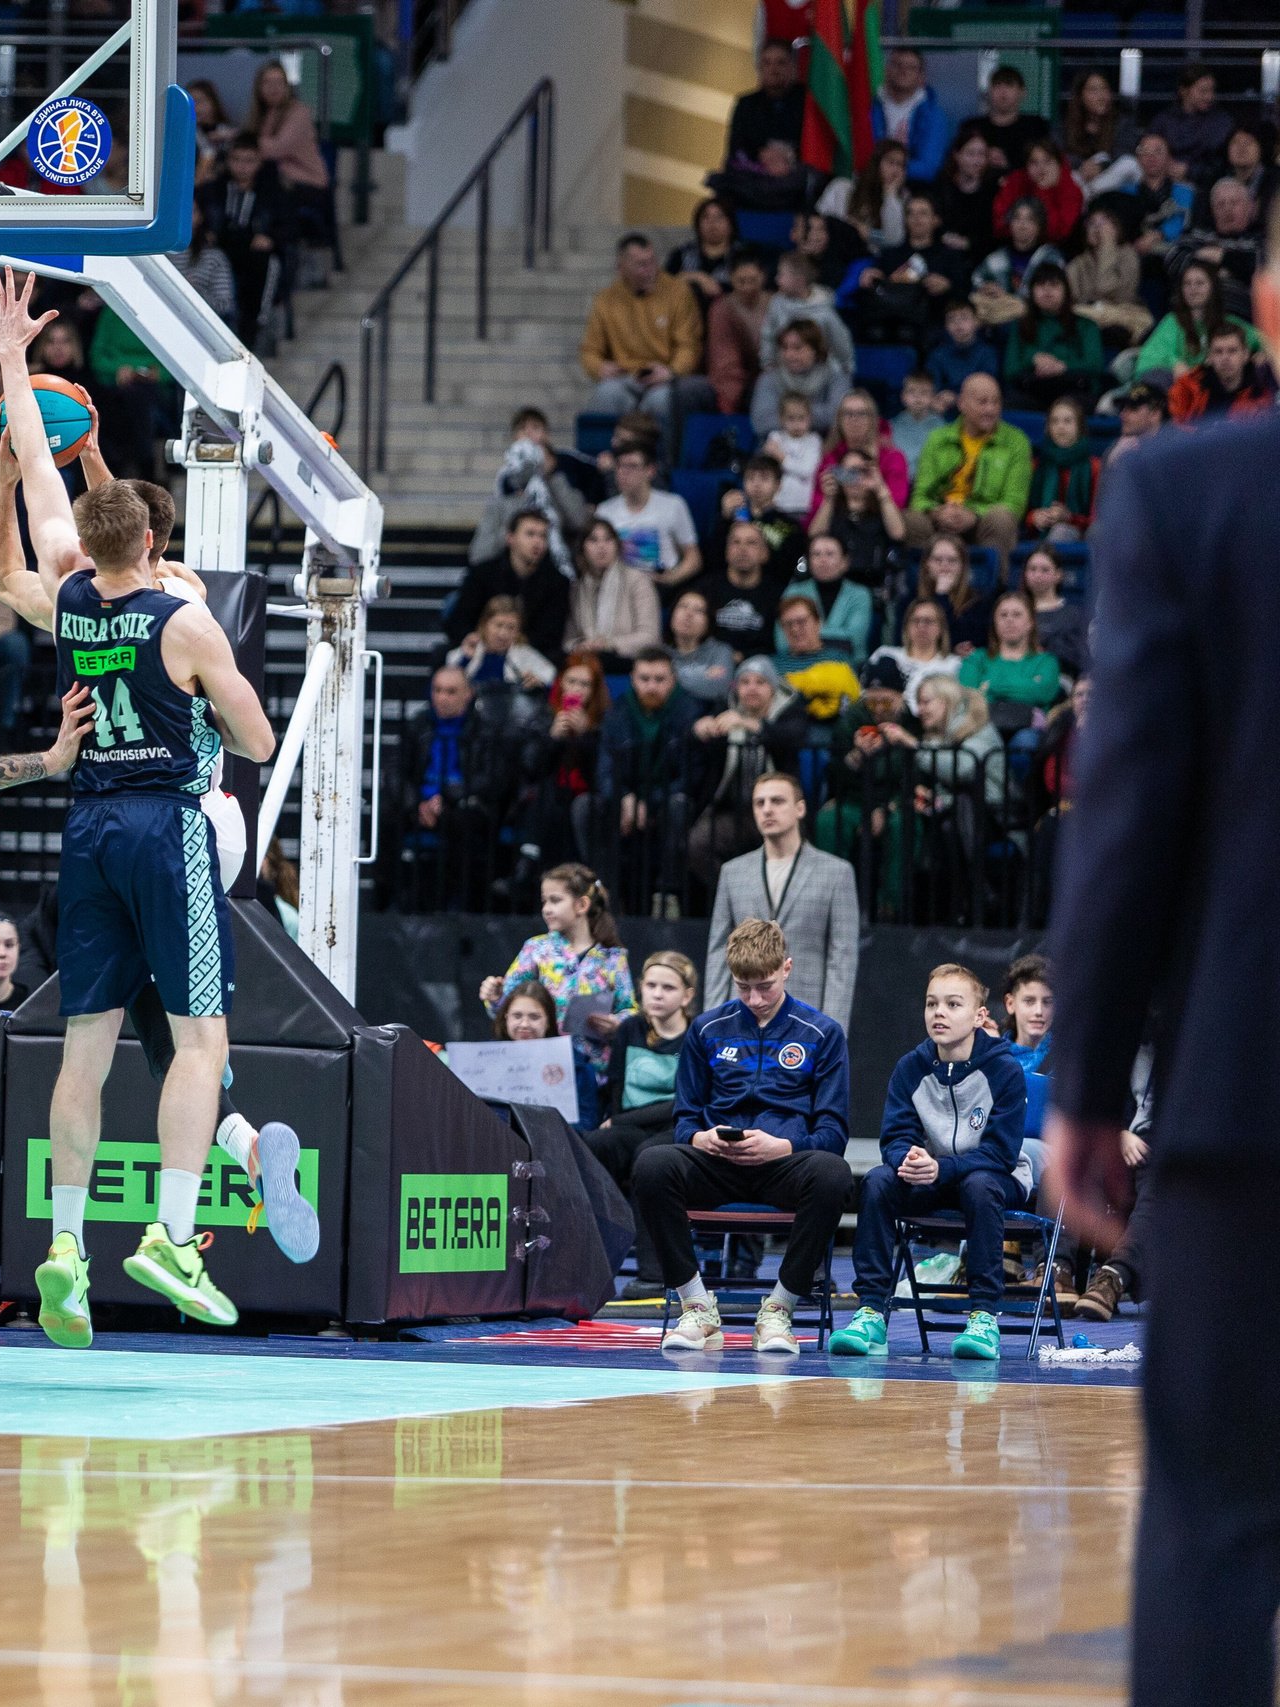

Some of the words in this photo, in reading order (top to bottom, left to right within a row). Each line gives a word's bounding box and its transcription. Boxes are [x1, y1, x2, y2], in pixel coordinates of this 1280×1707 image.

[34, 100, 67, 125] ЕДИНАЯ
[69, 99, 91, 112] ЛИГА
[91, 109, 105, 126] ВТБ
[33, 156, 47, 173] VTB
[45, 170, 75, 184] UNITED
[76, 157, 105, 183] LEAGUE
